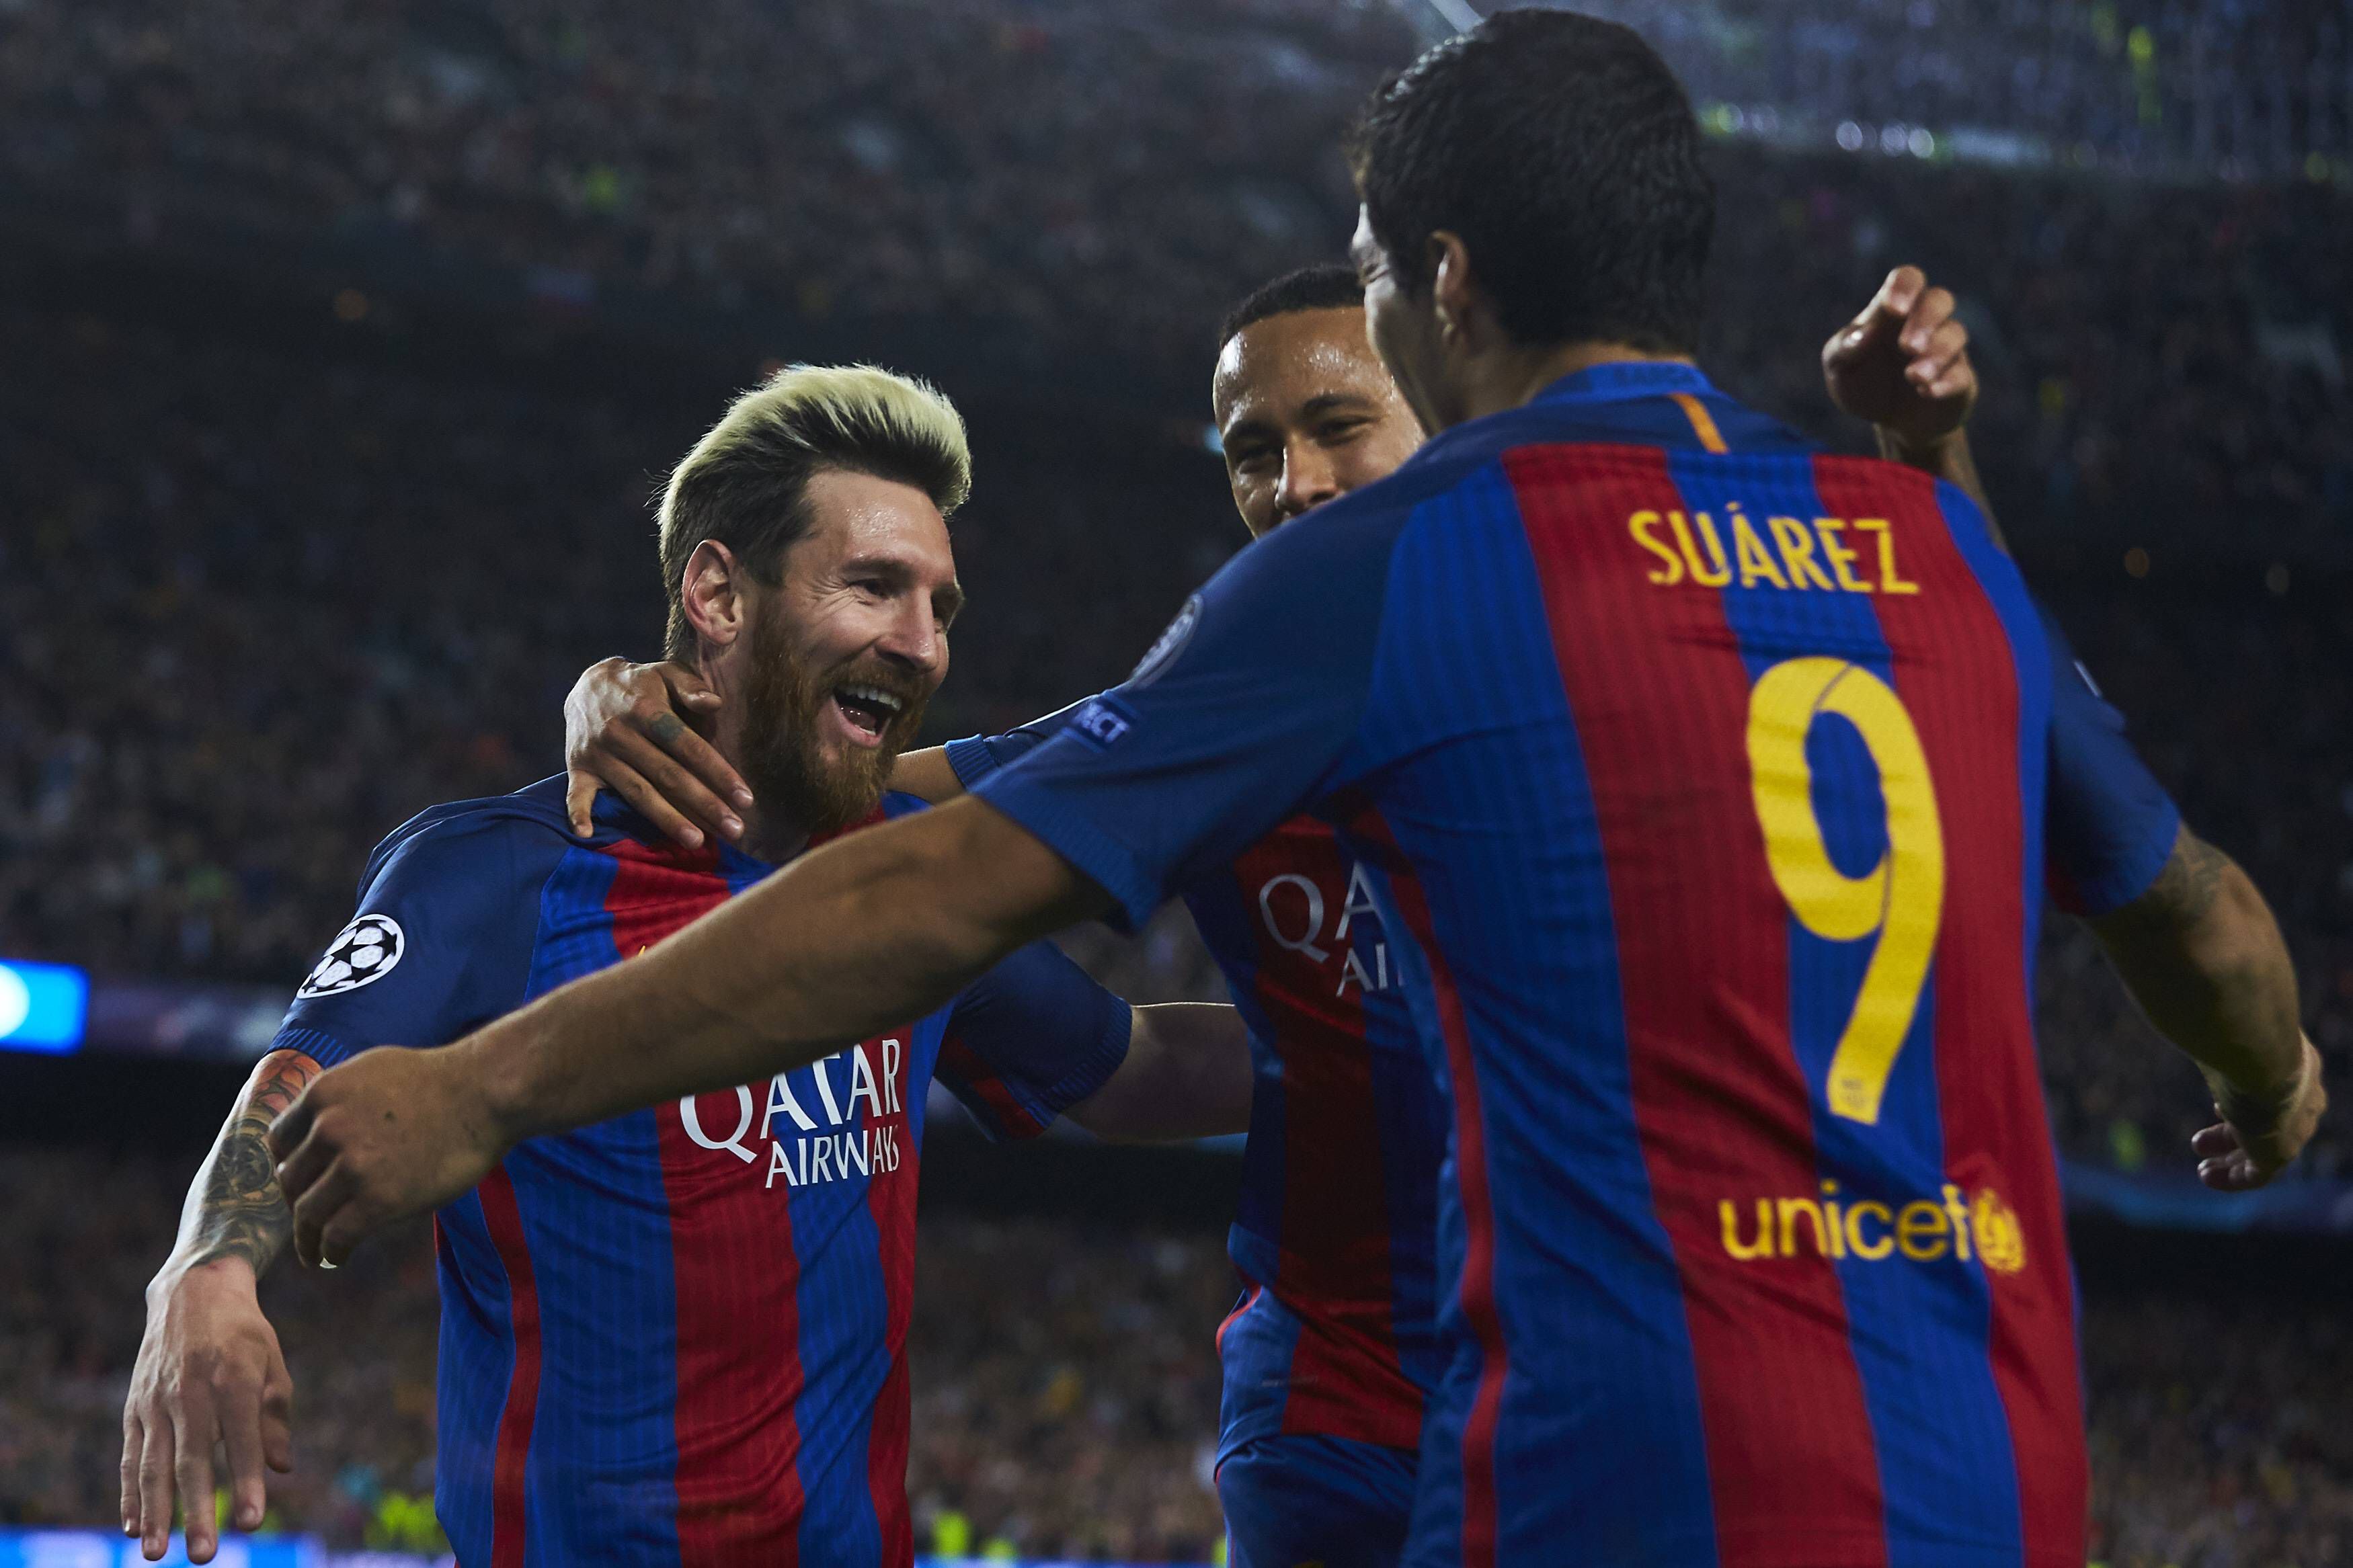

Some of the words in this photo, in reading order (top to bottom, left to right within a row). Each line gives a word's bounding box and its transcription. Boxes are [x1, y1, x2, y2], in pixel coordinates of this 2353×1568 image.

[1628, 501, 1921, 593] SUÁREZ
[1746, 656, 1946, 1126] 9
[680, 1038, 901, 1164] QATAR
[1718, 1178, 1971, 1261] unicef
